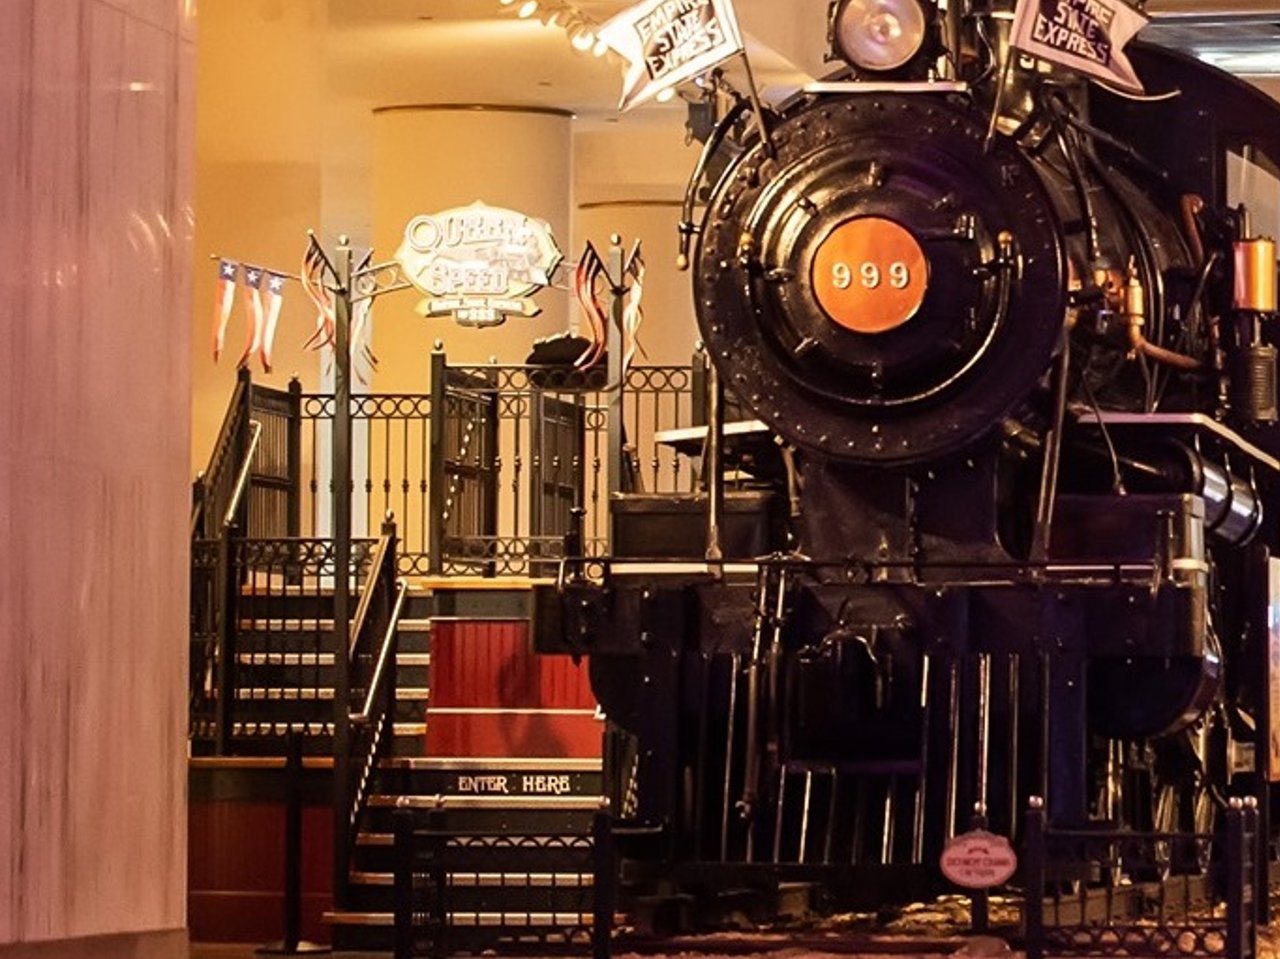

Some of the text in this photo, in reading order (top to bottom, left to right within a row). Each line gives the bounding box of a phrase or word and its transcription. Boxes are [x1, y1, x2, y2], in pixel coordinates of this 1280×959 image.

[1033, 13, 1109, 63] EXPRESS
[1053, 1, 1099, 39] STATE
[649, 16, 722, 81] EXPRESS
[832, 262, 909, 289] 999
[458, 775, 571, 795] ENTER HERE
